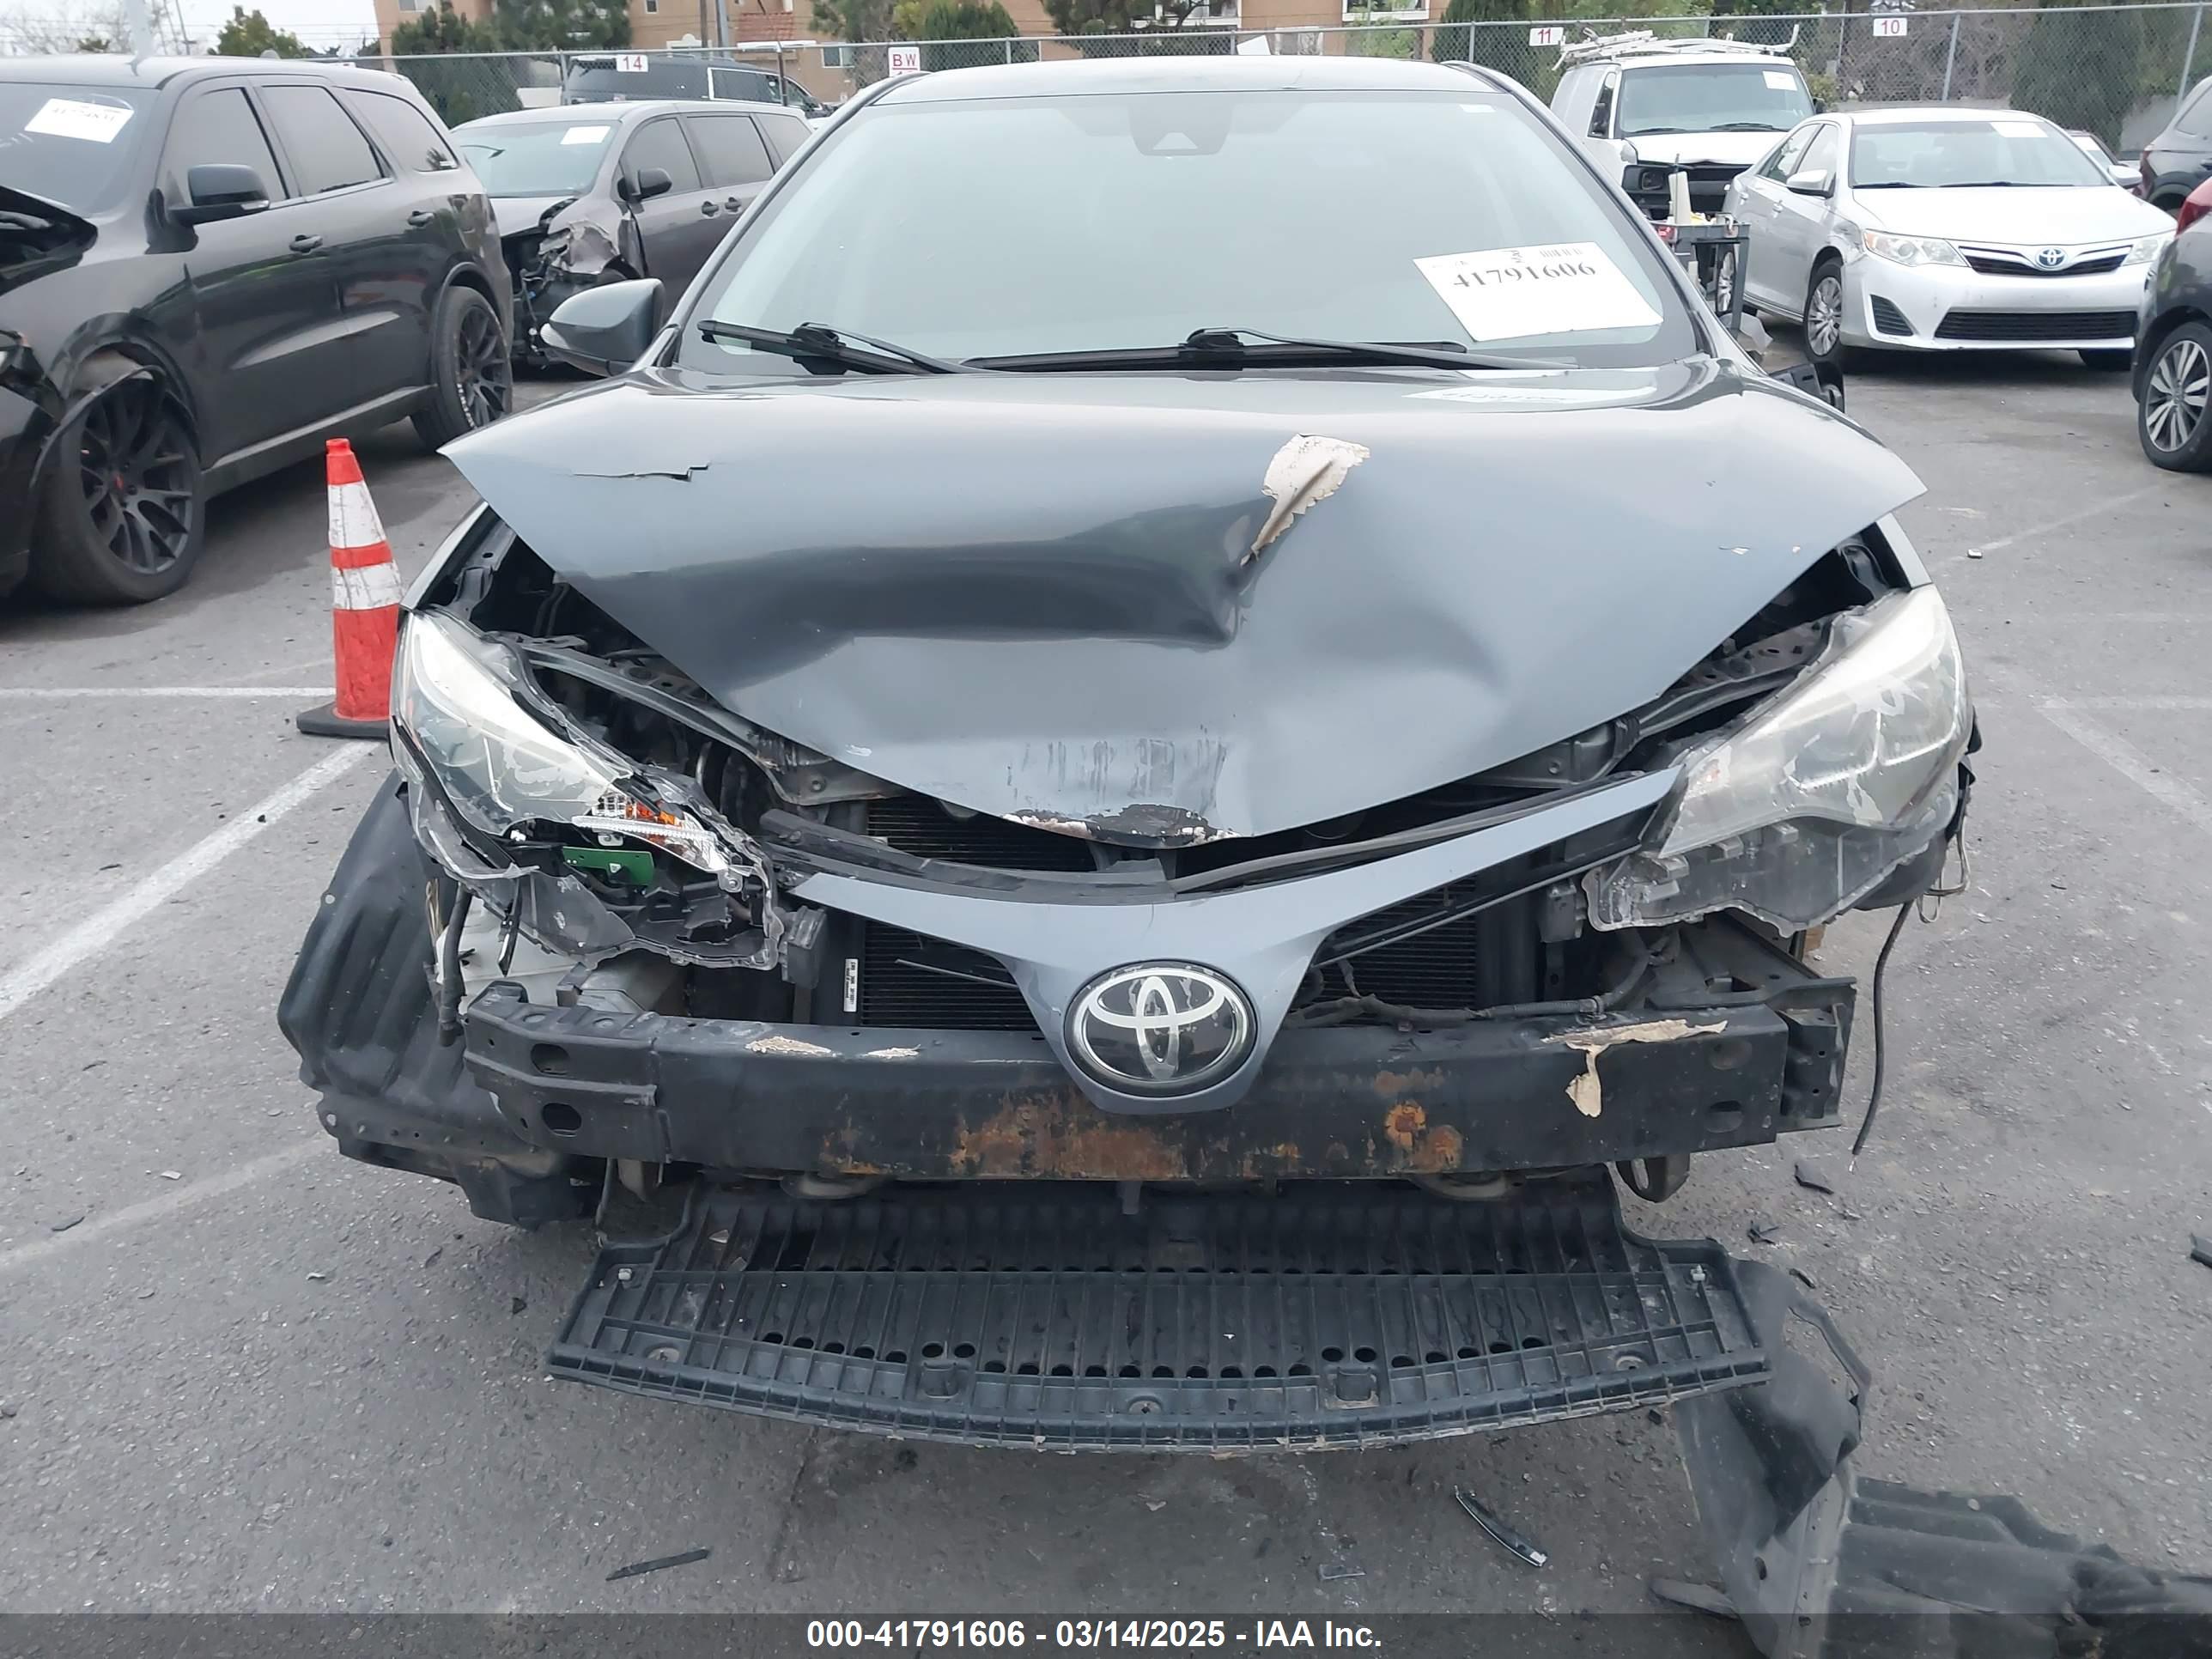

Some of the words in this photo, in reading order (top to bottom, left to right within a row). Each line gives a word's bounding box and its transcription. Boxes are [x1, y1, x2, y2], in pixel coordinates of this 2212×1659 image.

[1881, 20, 1900, 35] 10
[1538, 28, 1551, 44] 11
[623, 56, 642, 70] 14
[1453, 261, 1596, 288] 41791606
